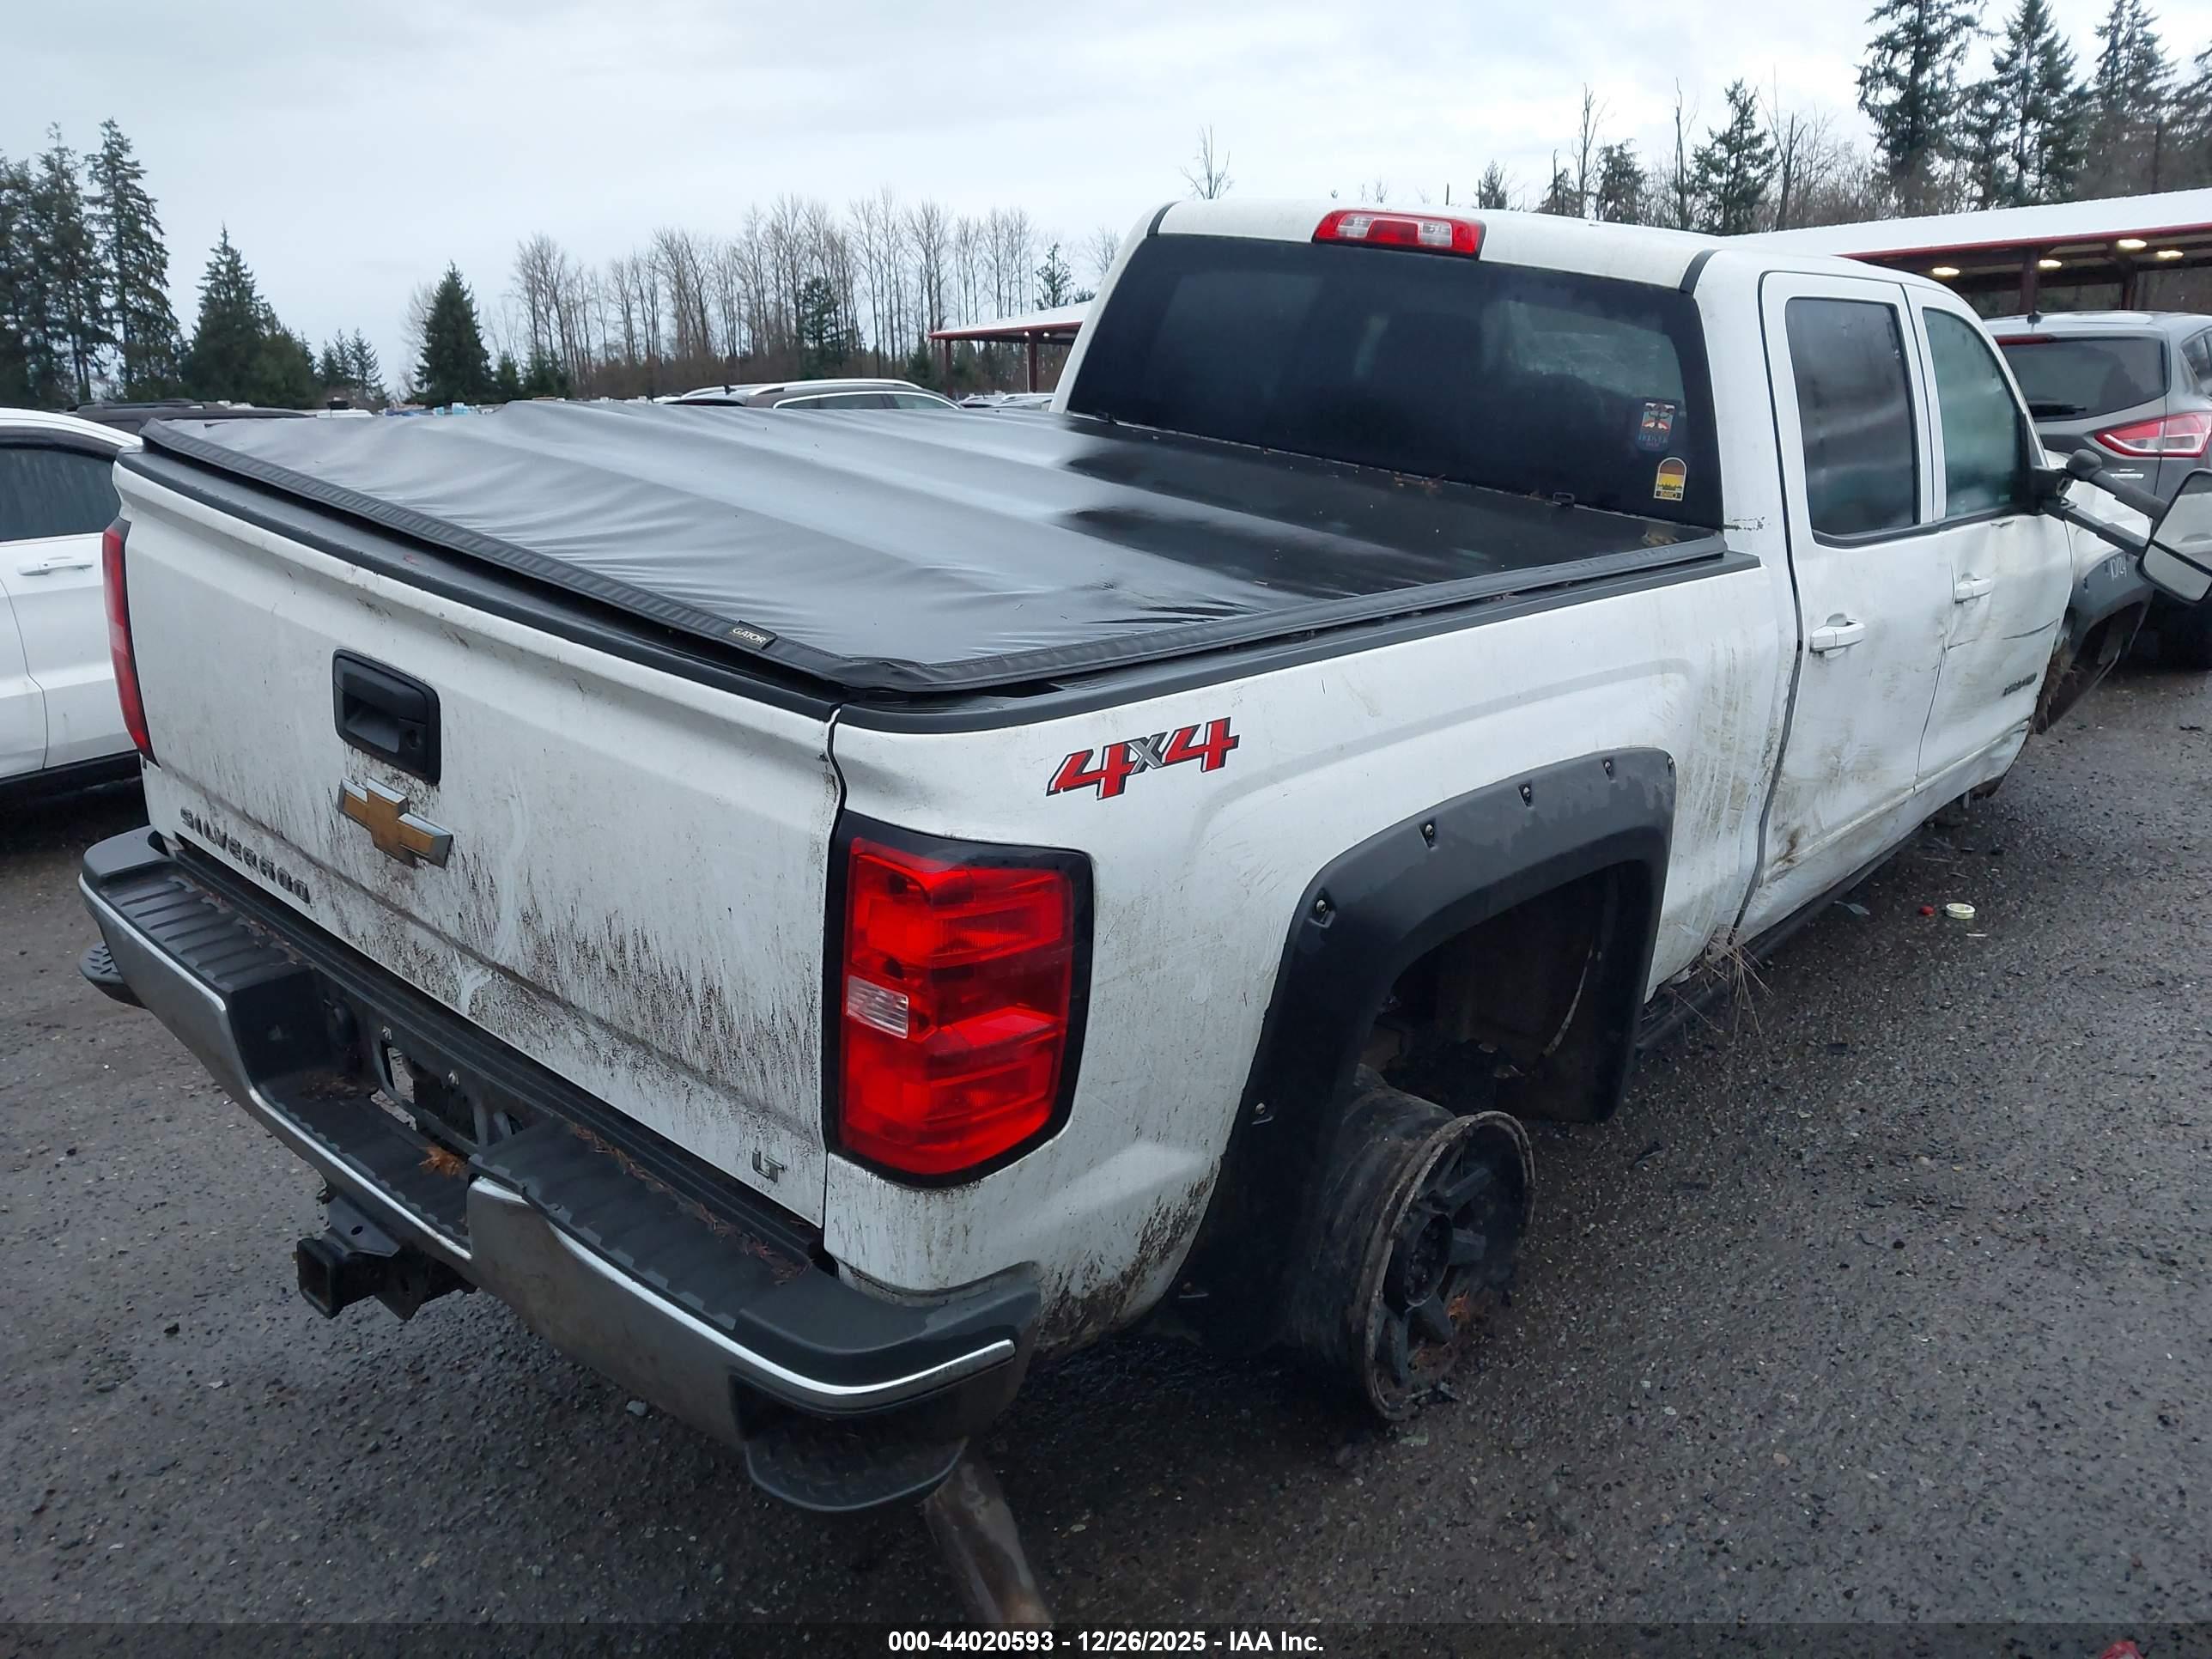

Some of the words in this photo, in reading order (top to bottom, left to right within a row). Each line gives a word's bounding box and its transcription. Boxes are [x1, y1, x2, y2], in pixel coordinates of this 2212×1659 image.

[732, 628, 767, 644] GATOR
[179, 806, 311, 904] SILVERADO
[751, 1151, 785, 1184] LT
